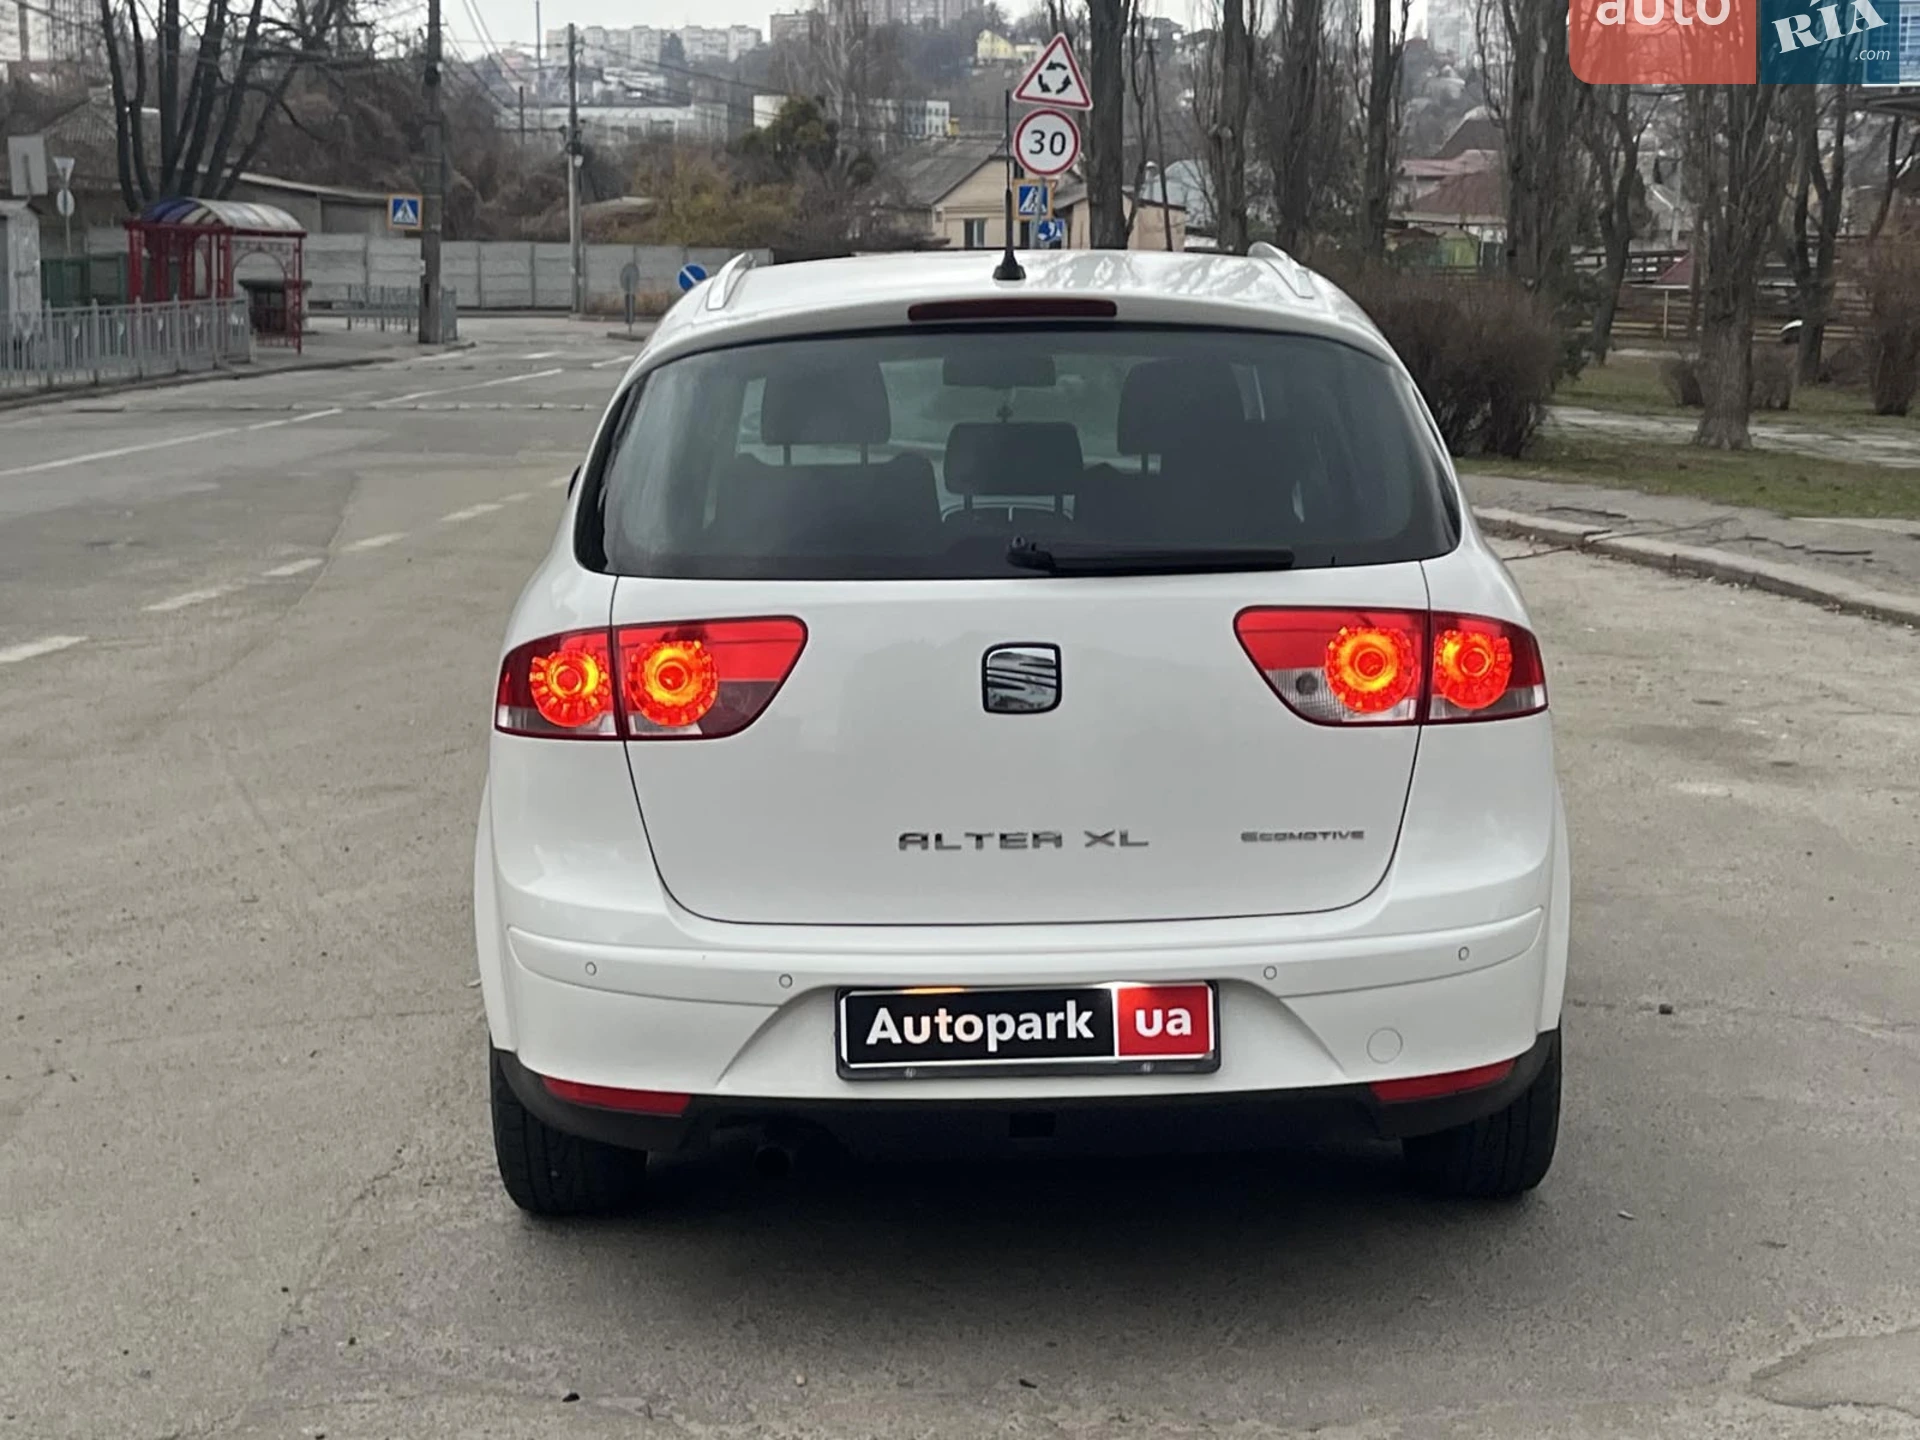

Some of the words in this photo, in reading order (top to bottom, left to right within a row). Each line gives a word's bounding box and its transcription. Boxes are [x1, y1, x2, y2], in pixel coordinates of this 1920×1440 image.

[1029, 129, 1066, 156] 30
[899, 831, 1063, 850] ALTEA
[1084, 829, 1149, 848] XL
[866, 1000, 1095, 1053] Autopark
[1135, 1007, 1192, 1037] ua
